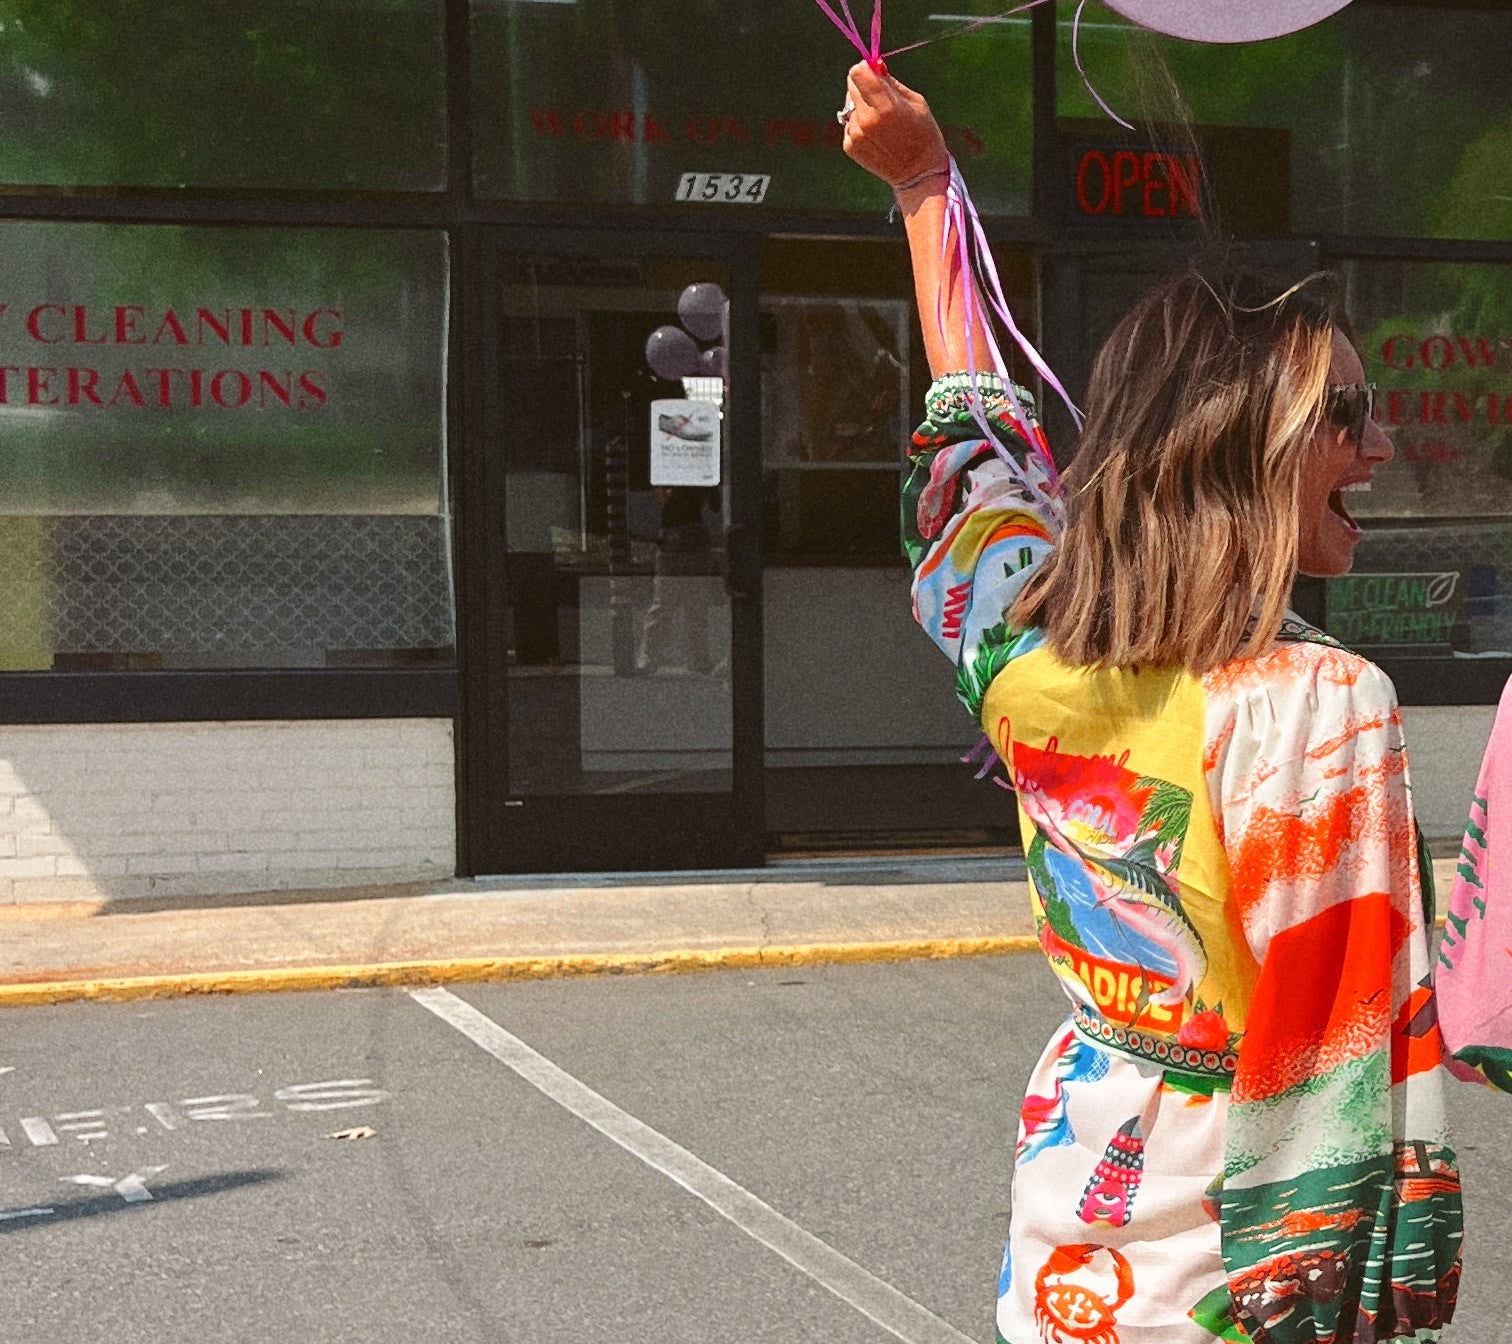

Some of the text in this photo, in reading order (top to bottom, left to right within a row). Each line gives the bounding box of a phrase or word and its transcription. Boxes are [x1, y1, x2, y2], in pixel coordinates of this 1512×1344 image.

[530, 108, 673, 144] WORK
[688, 116, 750, 146] ON
[686, 175, 764, 201] 1534
[1077, 151, 1199, 216] OPEN
[26, 303, 344, 348] CLEANING
